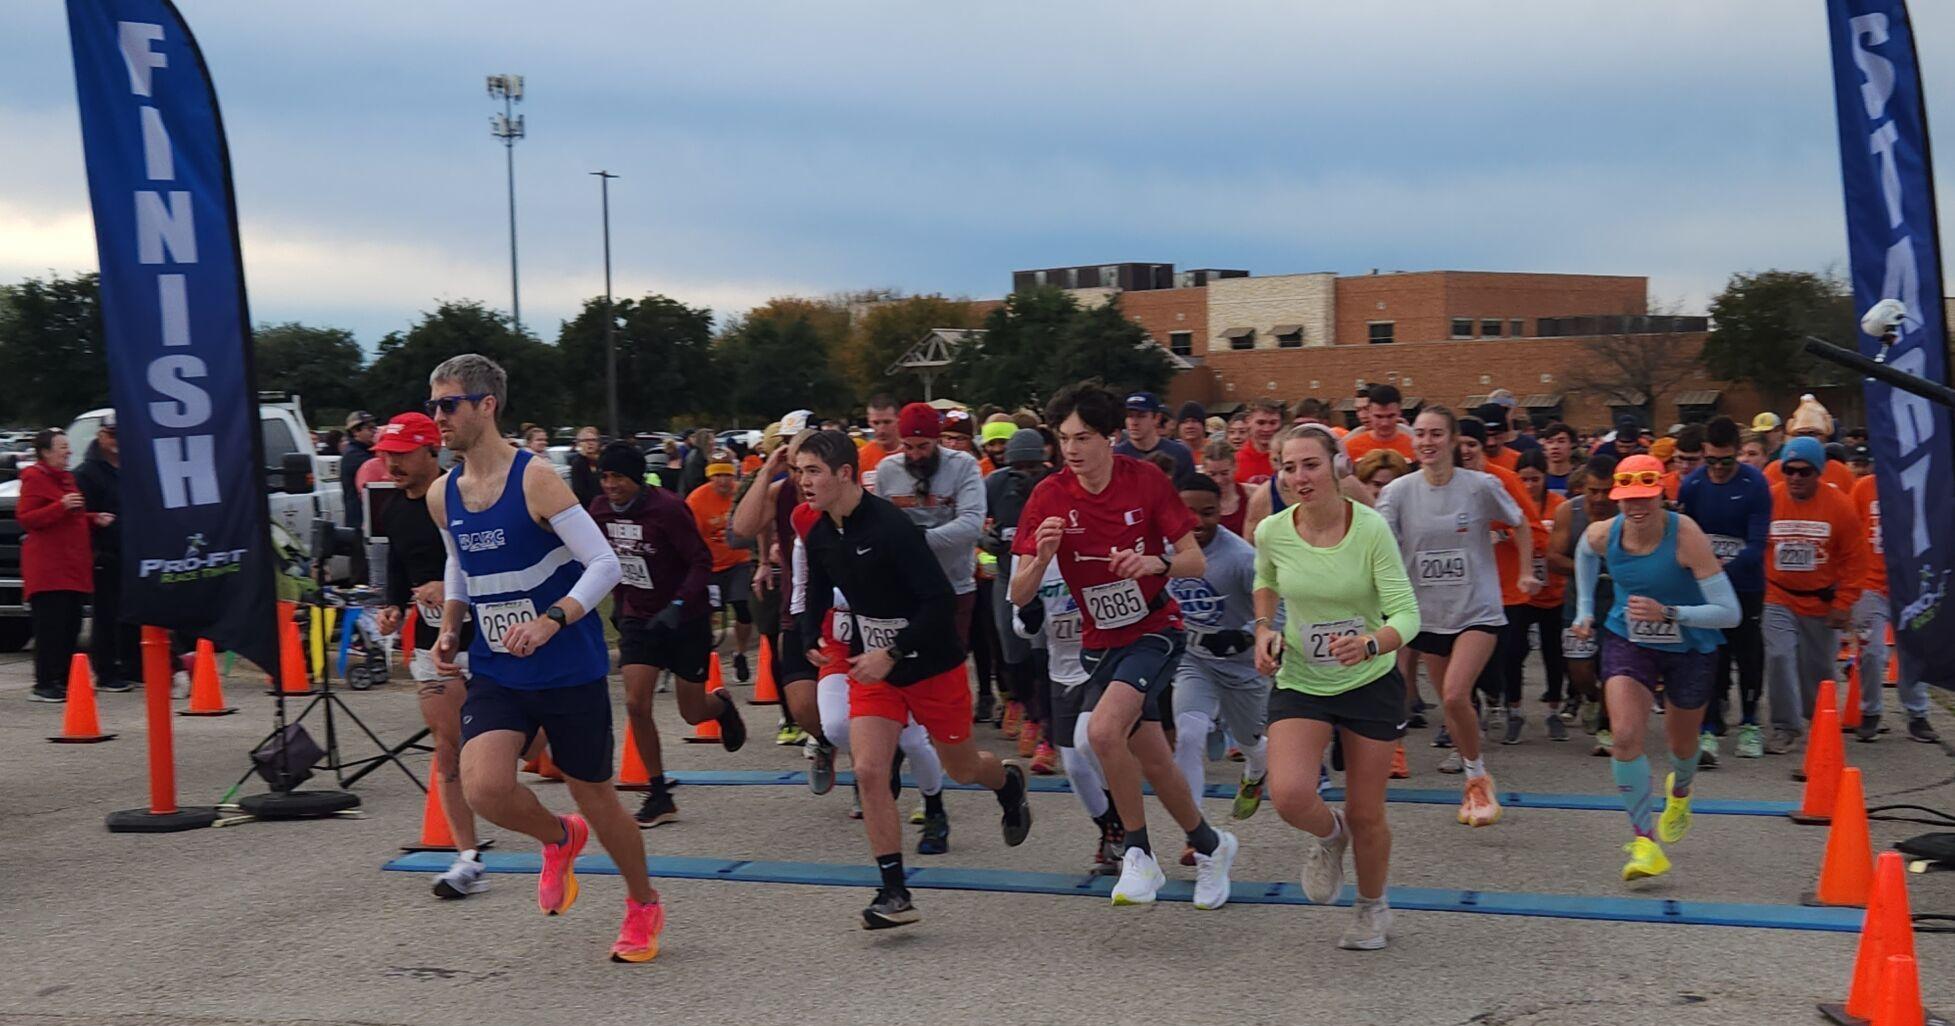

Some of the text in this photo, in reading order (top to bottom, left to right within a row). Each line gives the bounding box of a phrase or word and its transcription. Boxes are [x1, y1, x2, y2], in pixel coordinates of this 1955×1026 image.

[118, 21, 222, 509] FINISH
[1848, 12, 1933, 557] START
[1420, 557, 1465, 579] 2049
[1089, 588, 1142, 620] 2685
[863, 625, 896, 649] 266
